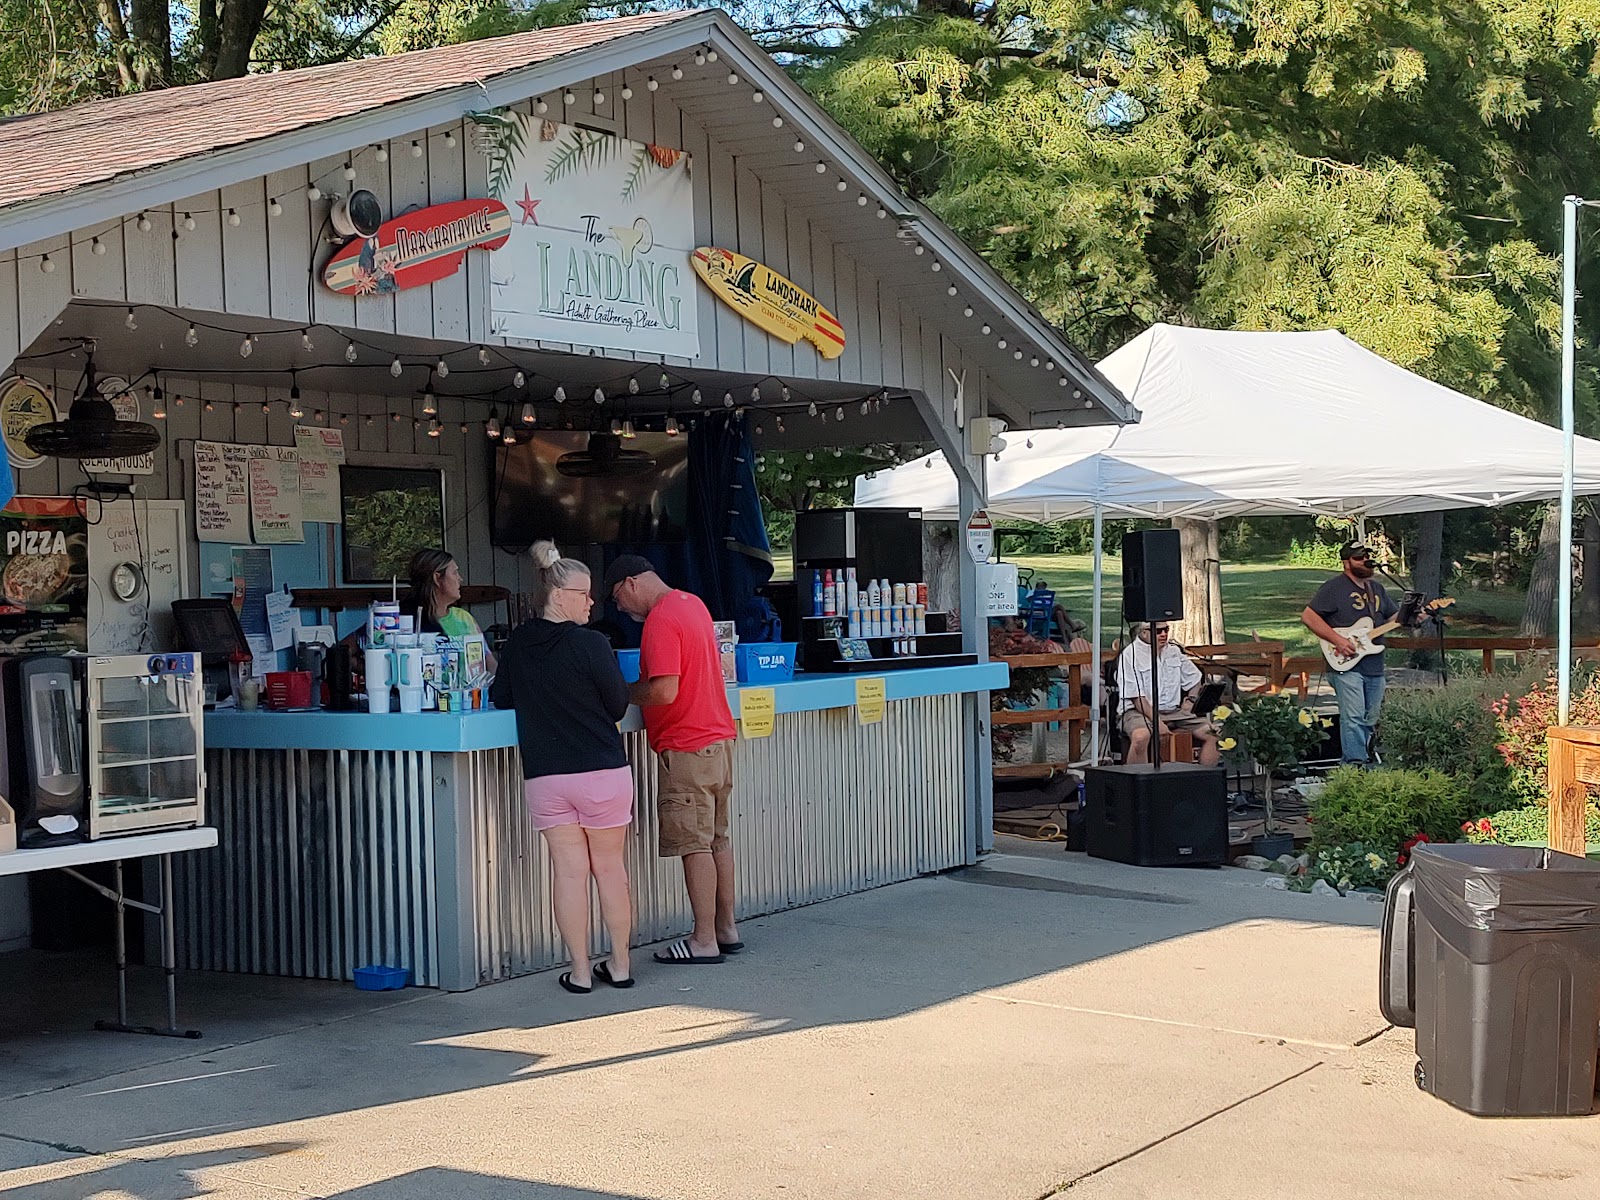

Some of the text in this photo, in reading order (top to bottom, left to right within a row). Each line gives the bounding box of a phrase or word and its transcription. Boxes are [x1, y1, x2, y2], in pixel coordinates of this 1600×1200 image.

[395, 206, 492, 261] MARGARITAVILLE
[580, 215, 606, 247] The
[536, 241, 682, 331] LANDING
[765, 272, 818, 318] LANDSHARK
[566, 300, 660, 333] Adult Gathering Place
[6, 530, 67, 556] PIZZA
[1349, 591, 1380, 612] 31
[758, 655, 785, 666] TIP JAR
